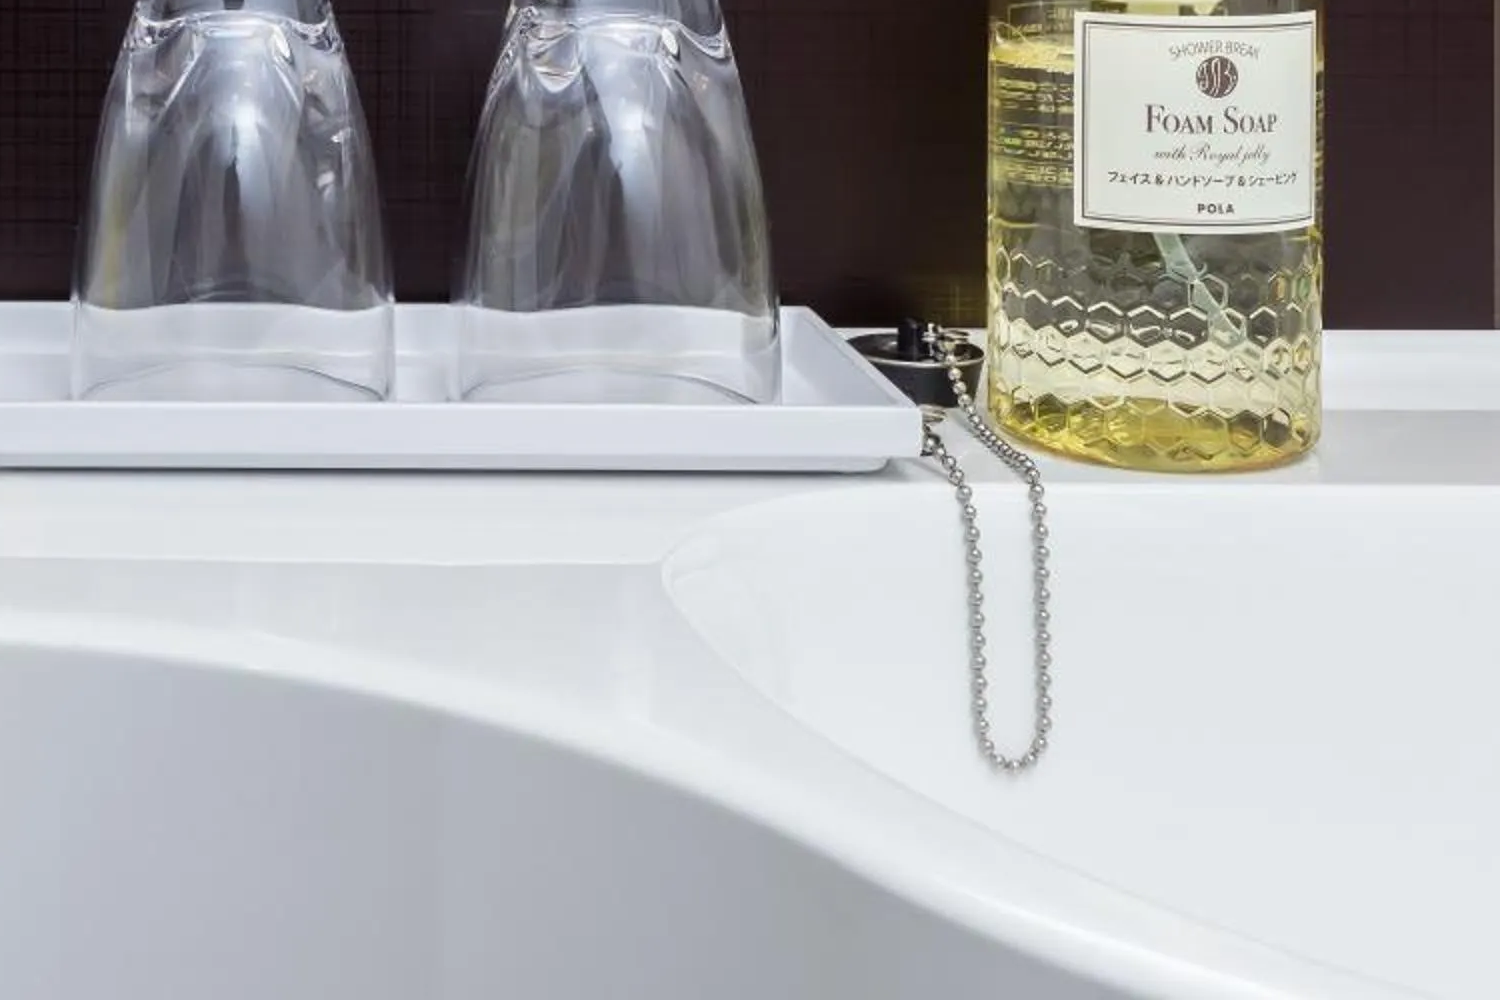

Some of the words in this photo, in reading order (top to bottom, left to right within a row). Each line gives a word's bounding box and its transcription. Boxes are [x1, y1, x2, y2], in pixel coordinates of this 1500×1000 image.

[1168, 39, 1223, 59] SHOWER
[1145, 103, 1213, 134] FOAM
[1222, 105, 1277, 134] SOAP
[1154, 144, 1186, 160] with
[1197, 202, 1235, 215] POLA
